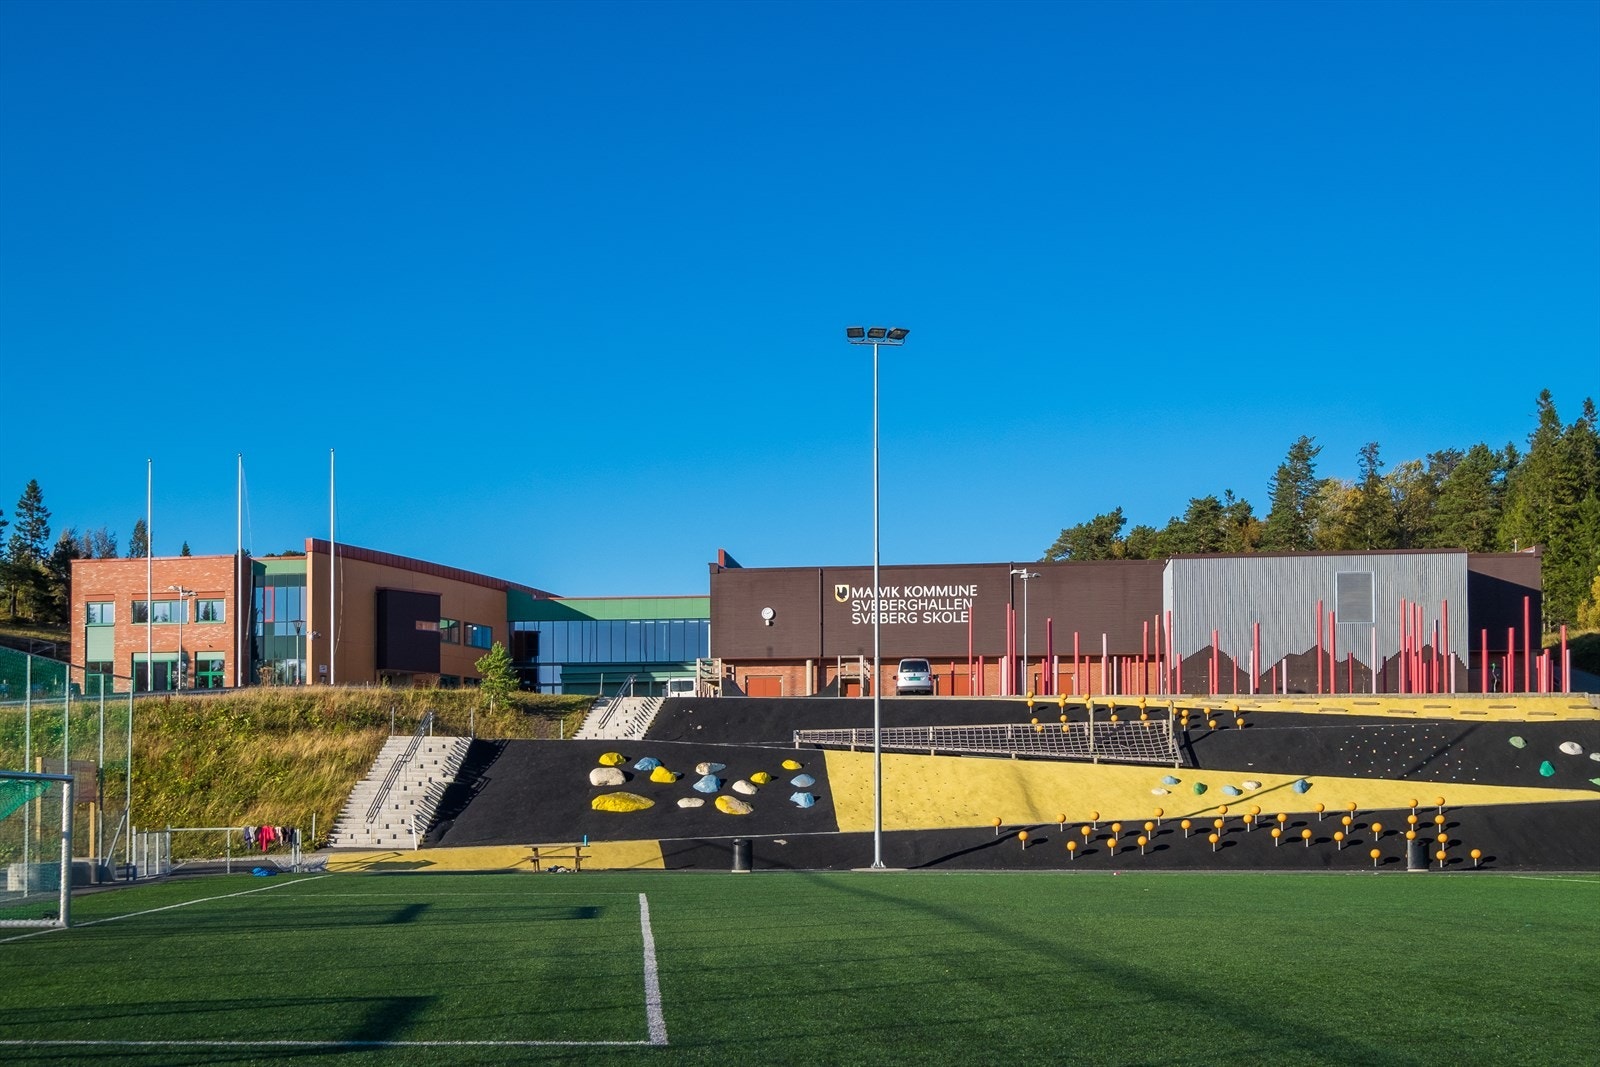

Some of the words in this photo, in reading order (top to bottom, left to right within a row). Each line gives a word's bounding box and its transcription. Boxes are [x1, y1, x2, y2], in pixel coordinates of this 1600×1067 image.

[852, 587, 900, 598] MAVIK
[904, 585, 977, 597] KOMMUNE
[922, 612, 969, 623] SKOLE
